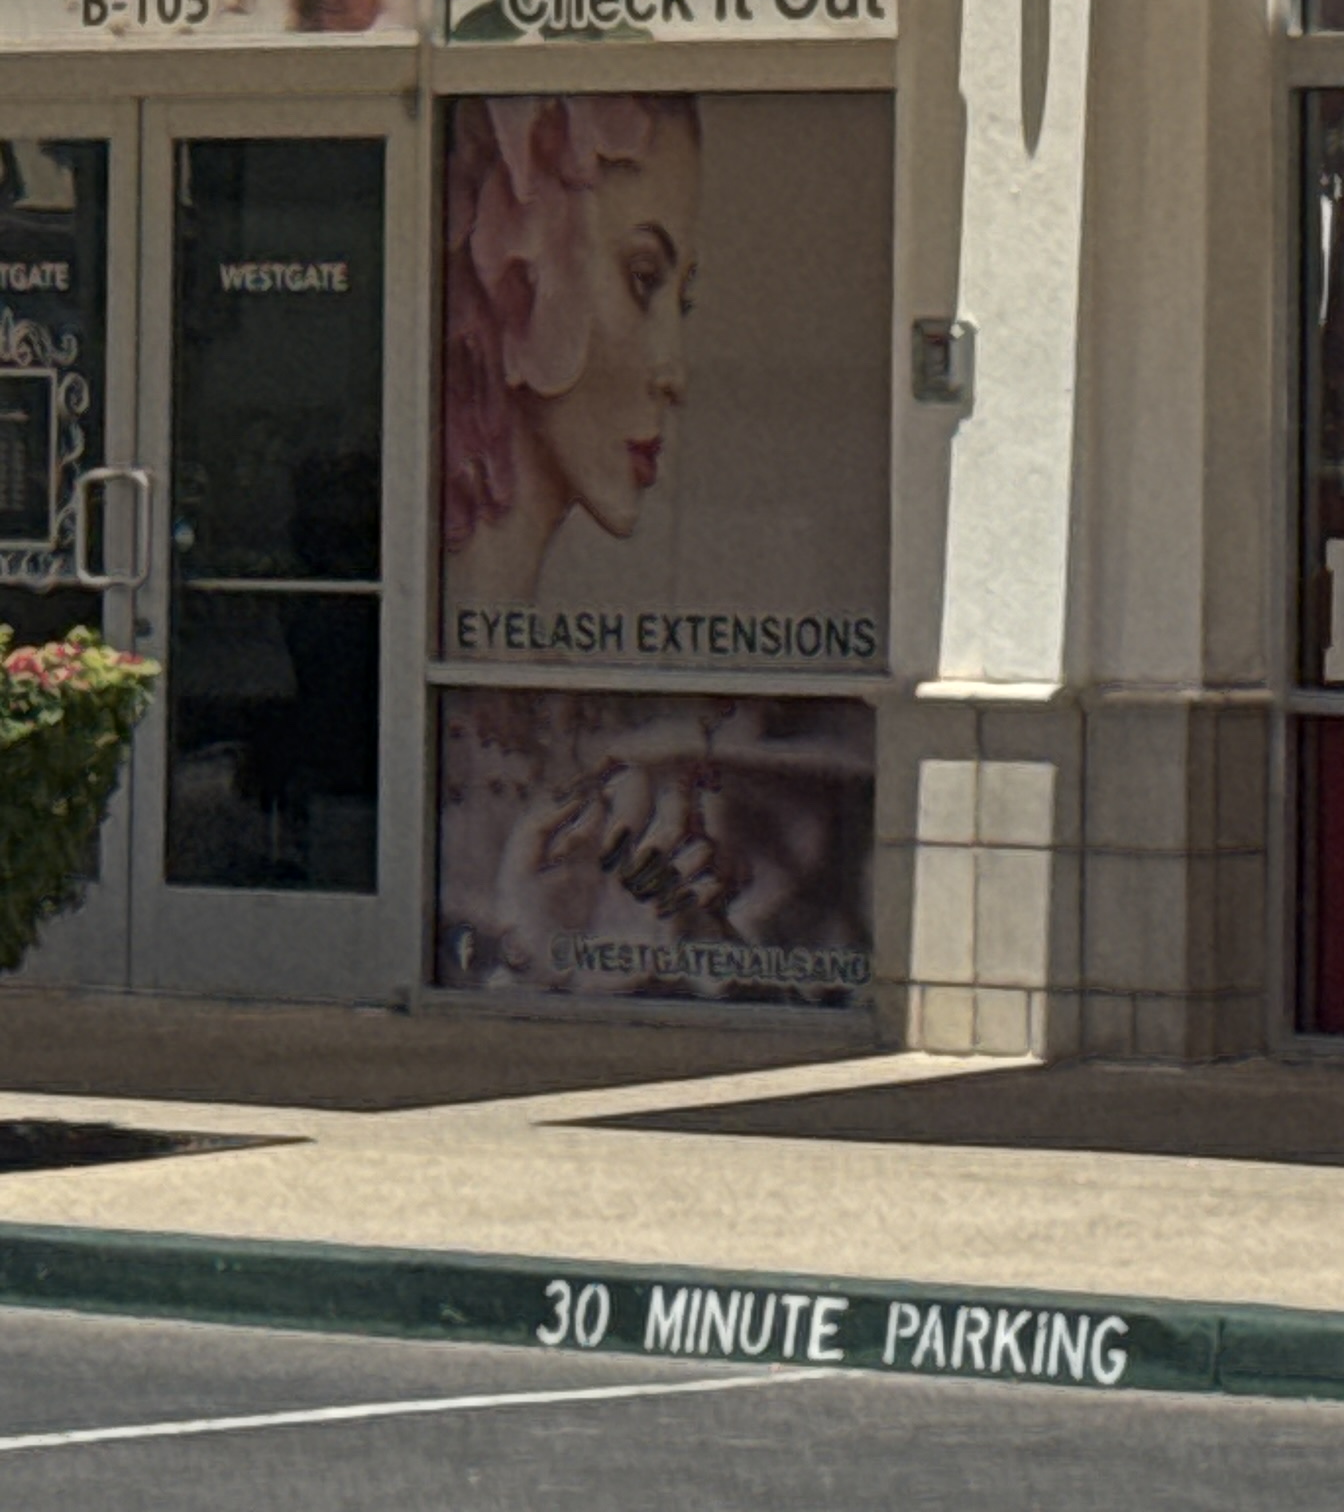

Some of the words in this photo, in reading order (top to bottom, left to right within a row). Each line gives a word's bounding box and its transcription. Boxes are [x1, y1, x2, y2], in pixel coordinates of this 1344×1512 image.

[218, 261, 350, 293] WESTGATE
[456, 608, 625, 653] EYELASH
[636, 612, 878, 659] EXTENSIONS
[535, 1279, 612, 1349] 30
[643, 1285, 850, 1362] MINUTE
[881, 1299, 1131, 1386] PARKING
